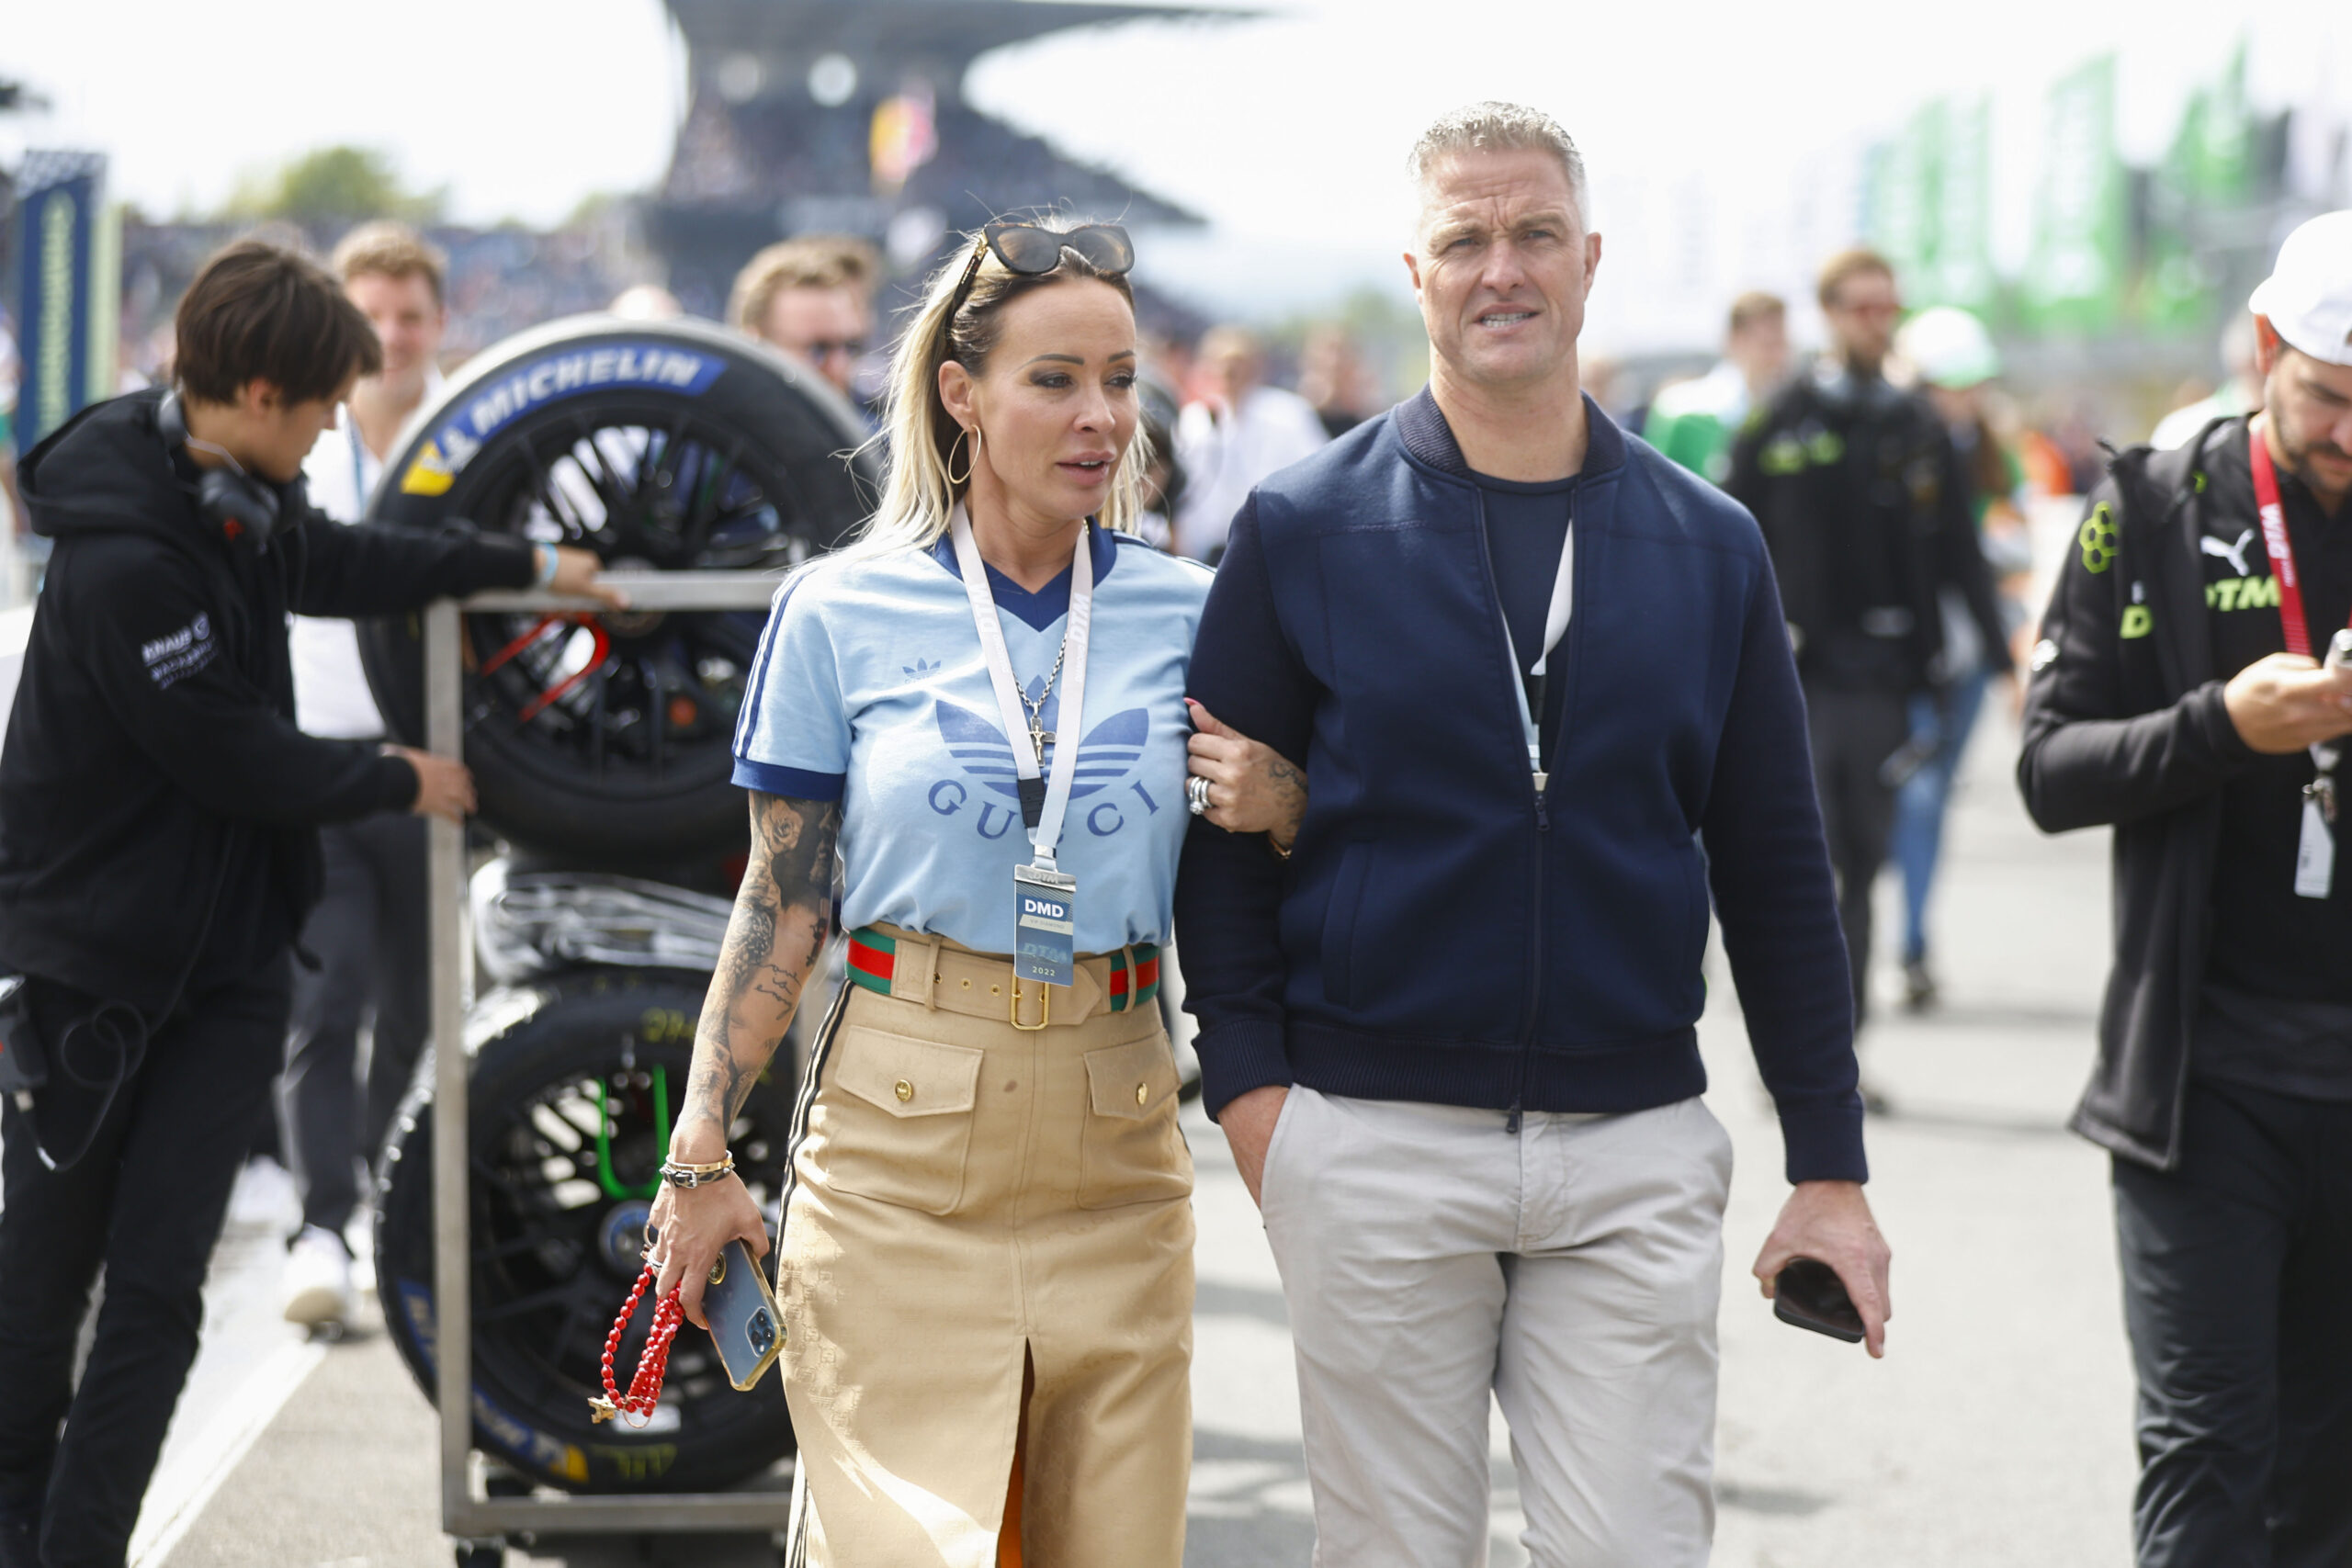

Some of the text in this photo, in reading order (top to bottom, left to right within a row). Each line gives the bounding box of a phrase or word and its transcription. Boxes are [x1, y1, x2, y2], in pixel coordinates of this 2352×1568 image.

[470, 348, 701, 435] MICHELIN
[1069, 592, 1091, 645] DTM
[928, 779, 1159, 840] GUCI
[1024, 898, 1064, 918] DMD
[1032, 966, 1056, 977] 2022
